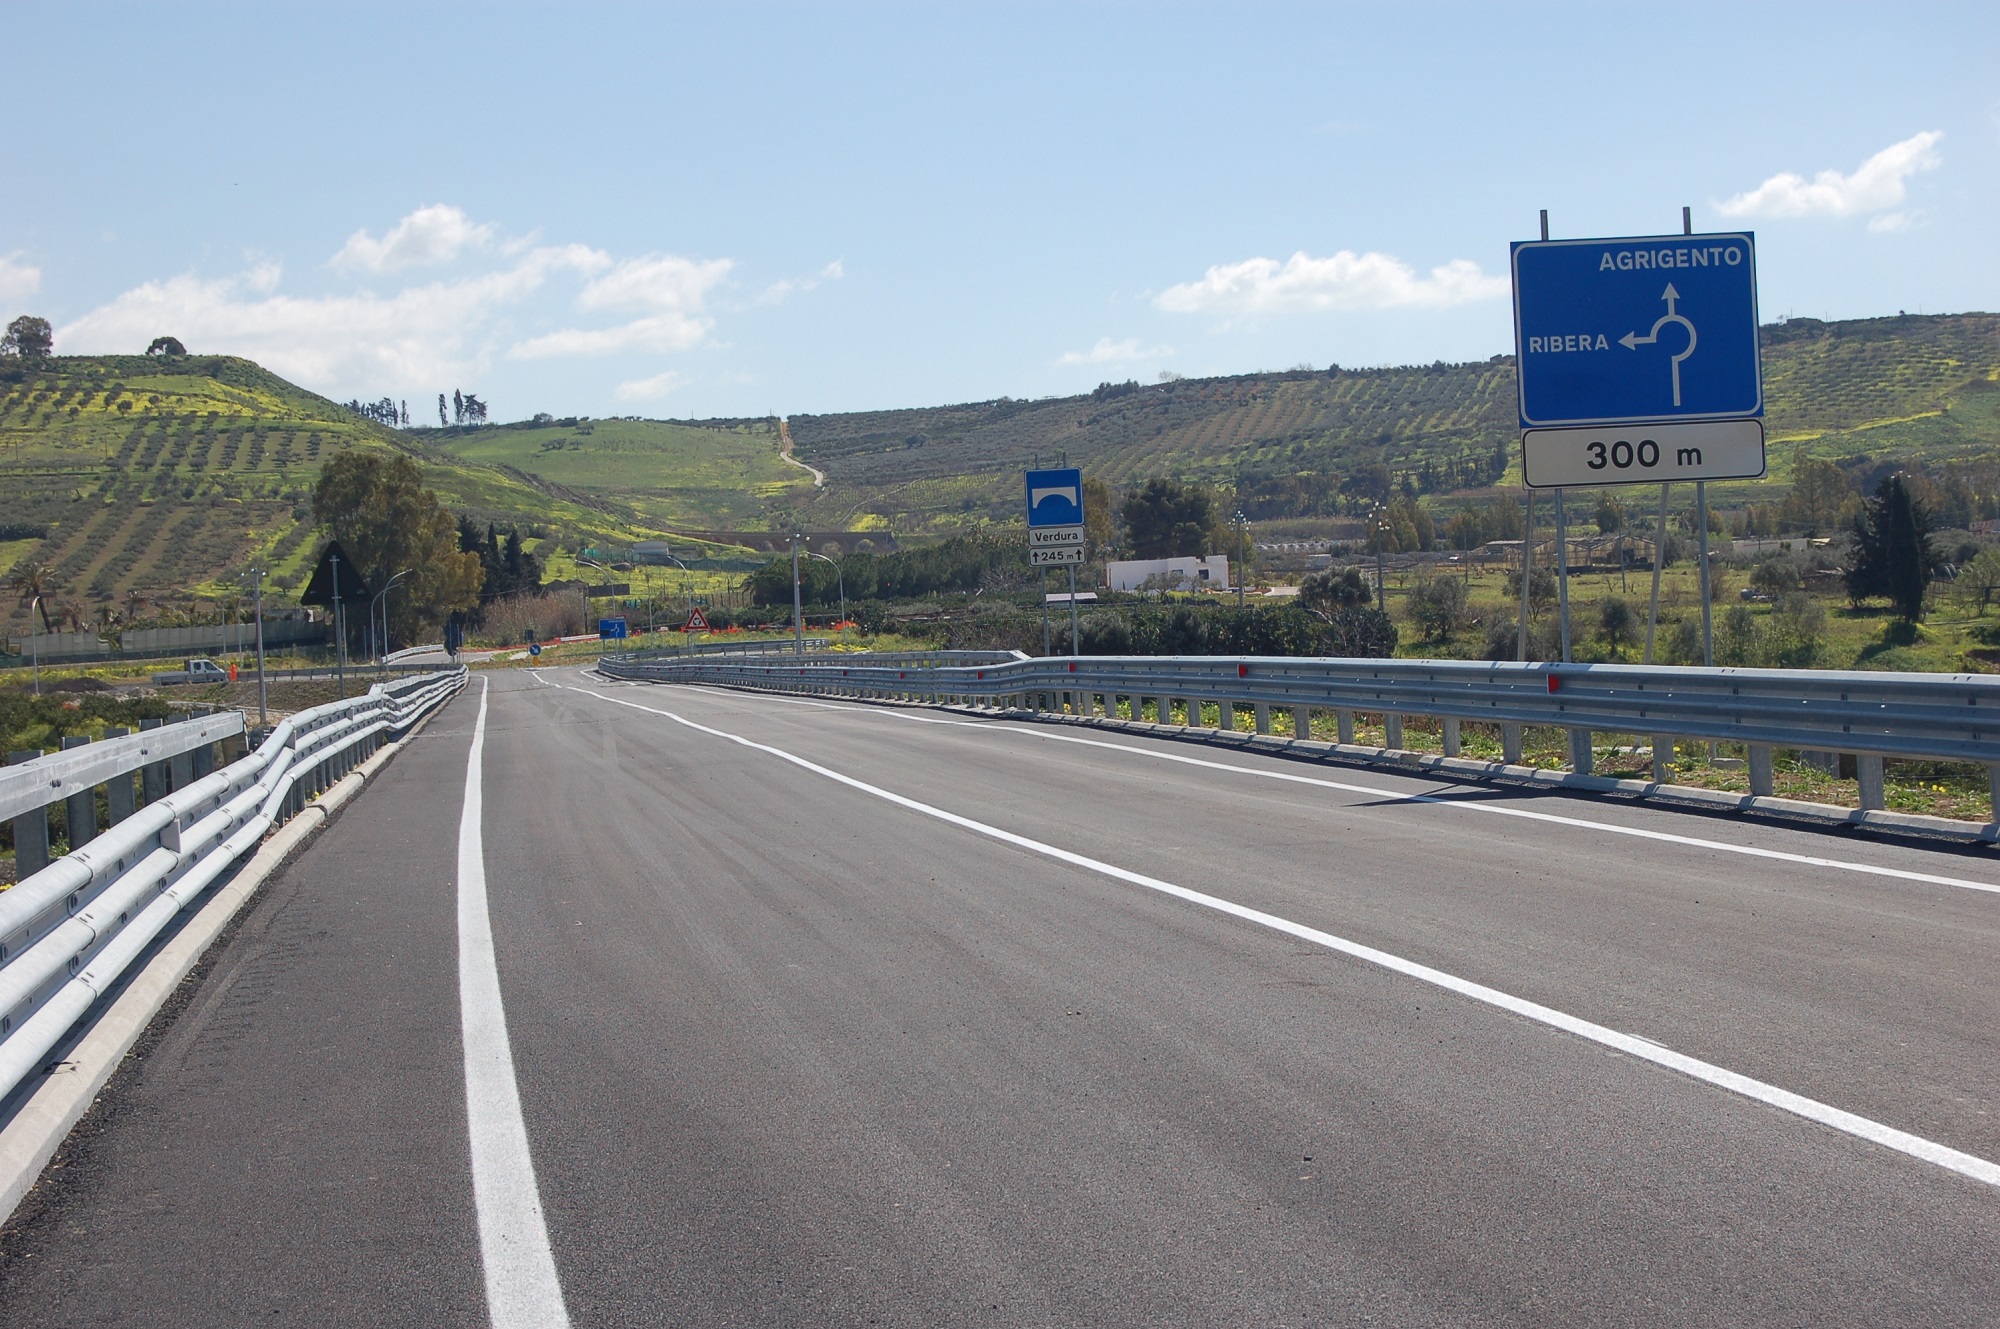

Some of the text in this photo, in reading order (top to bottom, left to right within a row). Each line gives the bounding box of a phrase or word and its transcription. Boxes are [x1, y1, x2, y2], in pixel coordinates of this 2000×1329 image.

[1599, 247, 1742, 271] AGRIGENTO
[1529, 334, 1609, 353] RIBERA
[1586, 440, 1702, 470] 300 m
[1035, 532, 1078, 542] Verdura
[1041, 552, 1064, 561] 245
